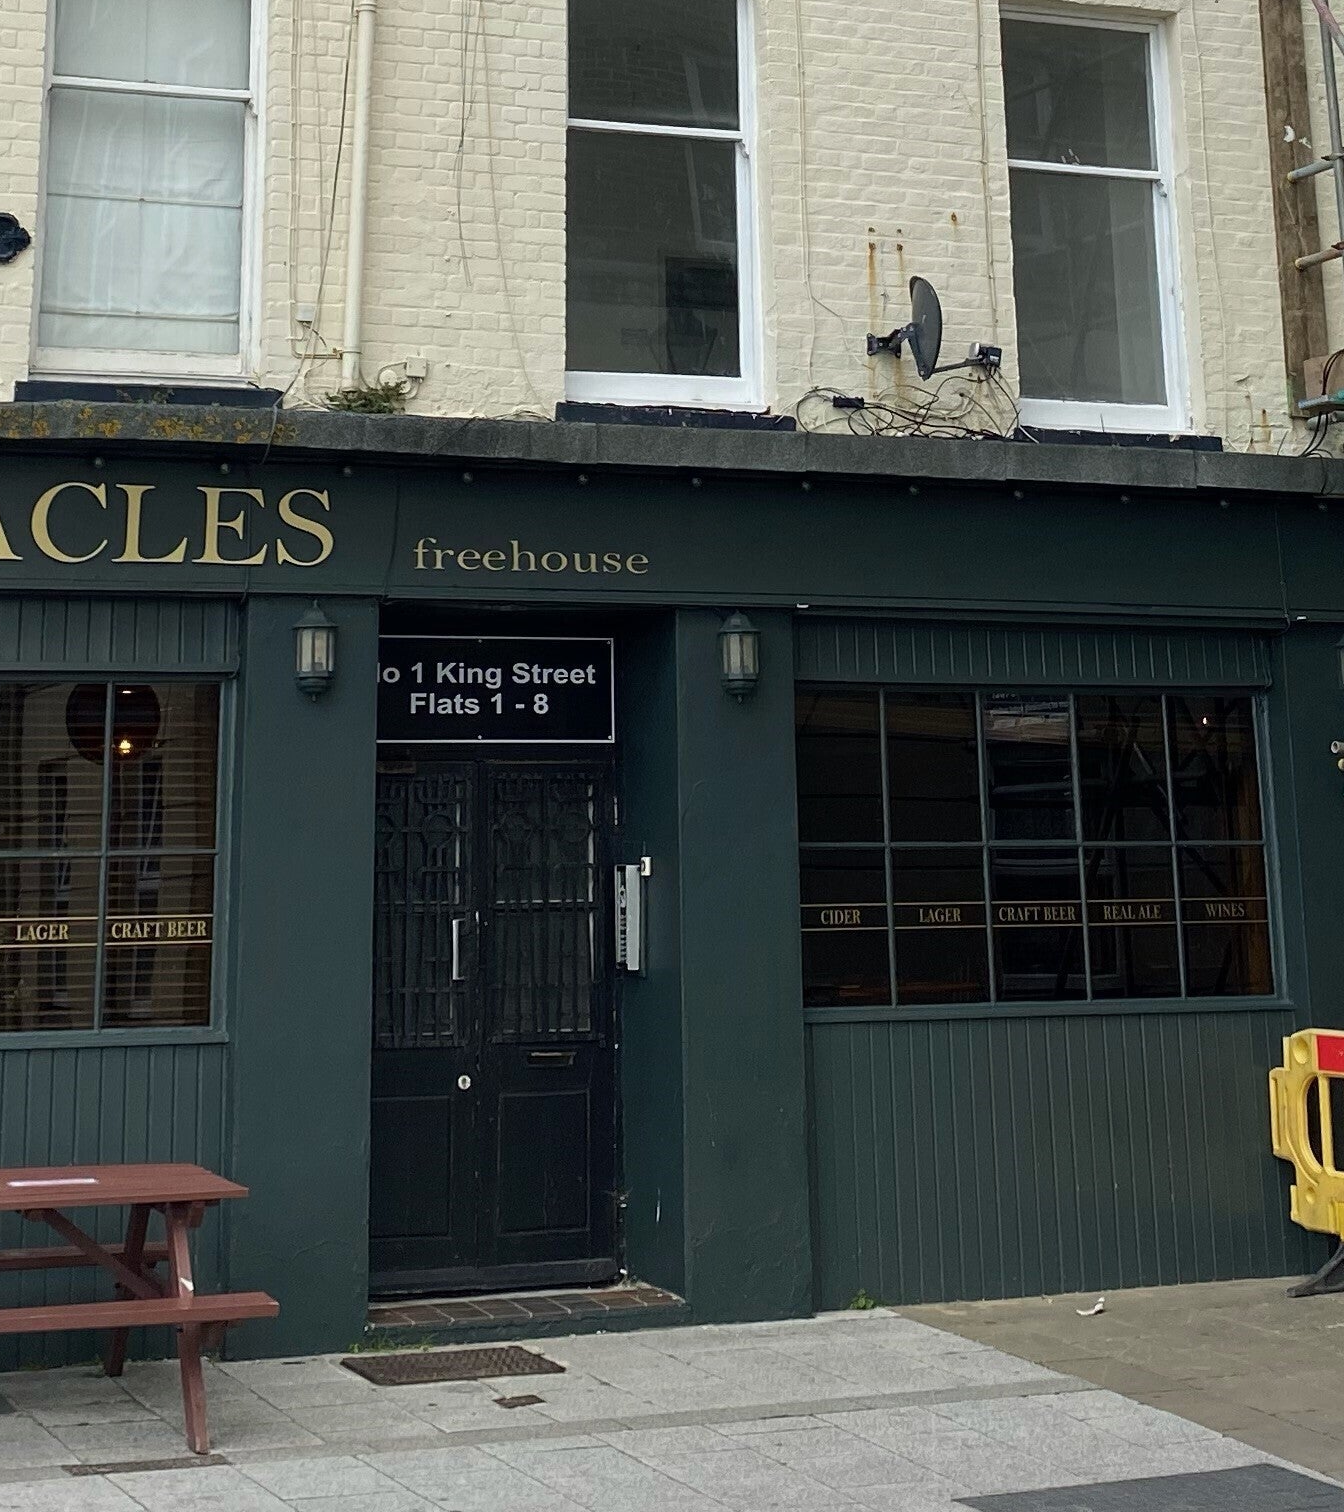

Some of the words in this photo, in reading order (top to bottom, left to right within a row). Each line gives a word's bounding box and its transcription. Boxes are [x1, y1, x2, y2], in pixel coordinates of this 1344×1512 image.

[412, 537, 650, 575] freehouse
[410, 662, 423, 684] 1
[436, 662, 502, 689] King
[512, 662, 596, 684] Street
[410, 692, 480, 715] Flats
[490, 692, 503, 714] 1
[533, 693, 549, 715] 8
[820, 909, 862, 925] CIDER
[918, 906, 962, 923] LAGER
[998, 906, 1041, 922] CRAFT
[1043, 905, 1076, 921] BEER
[1103, 904, 1136, 919] REAL
[1137, 903, 1161, 919] ALE
[1204, 902, 1245, 917] WINES
[15, 922, 70, 942] LAGER
[110, 921, 160, 939] CRAFT
[167, 919, 208, 938] BEER
